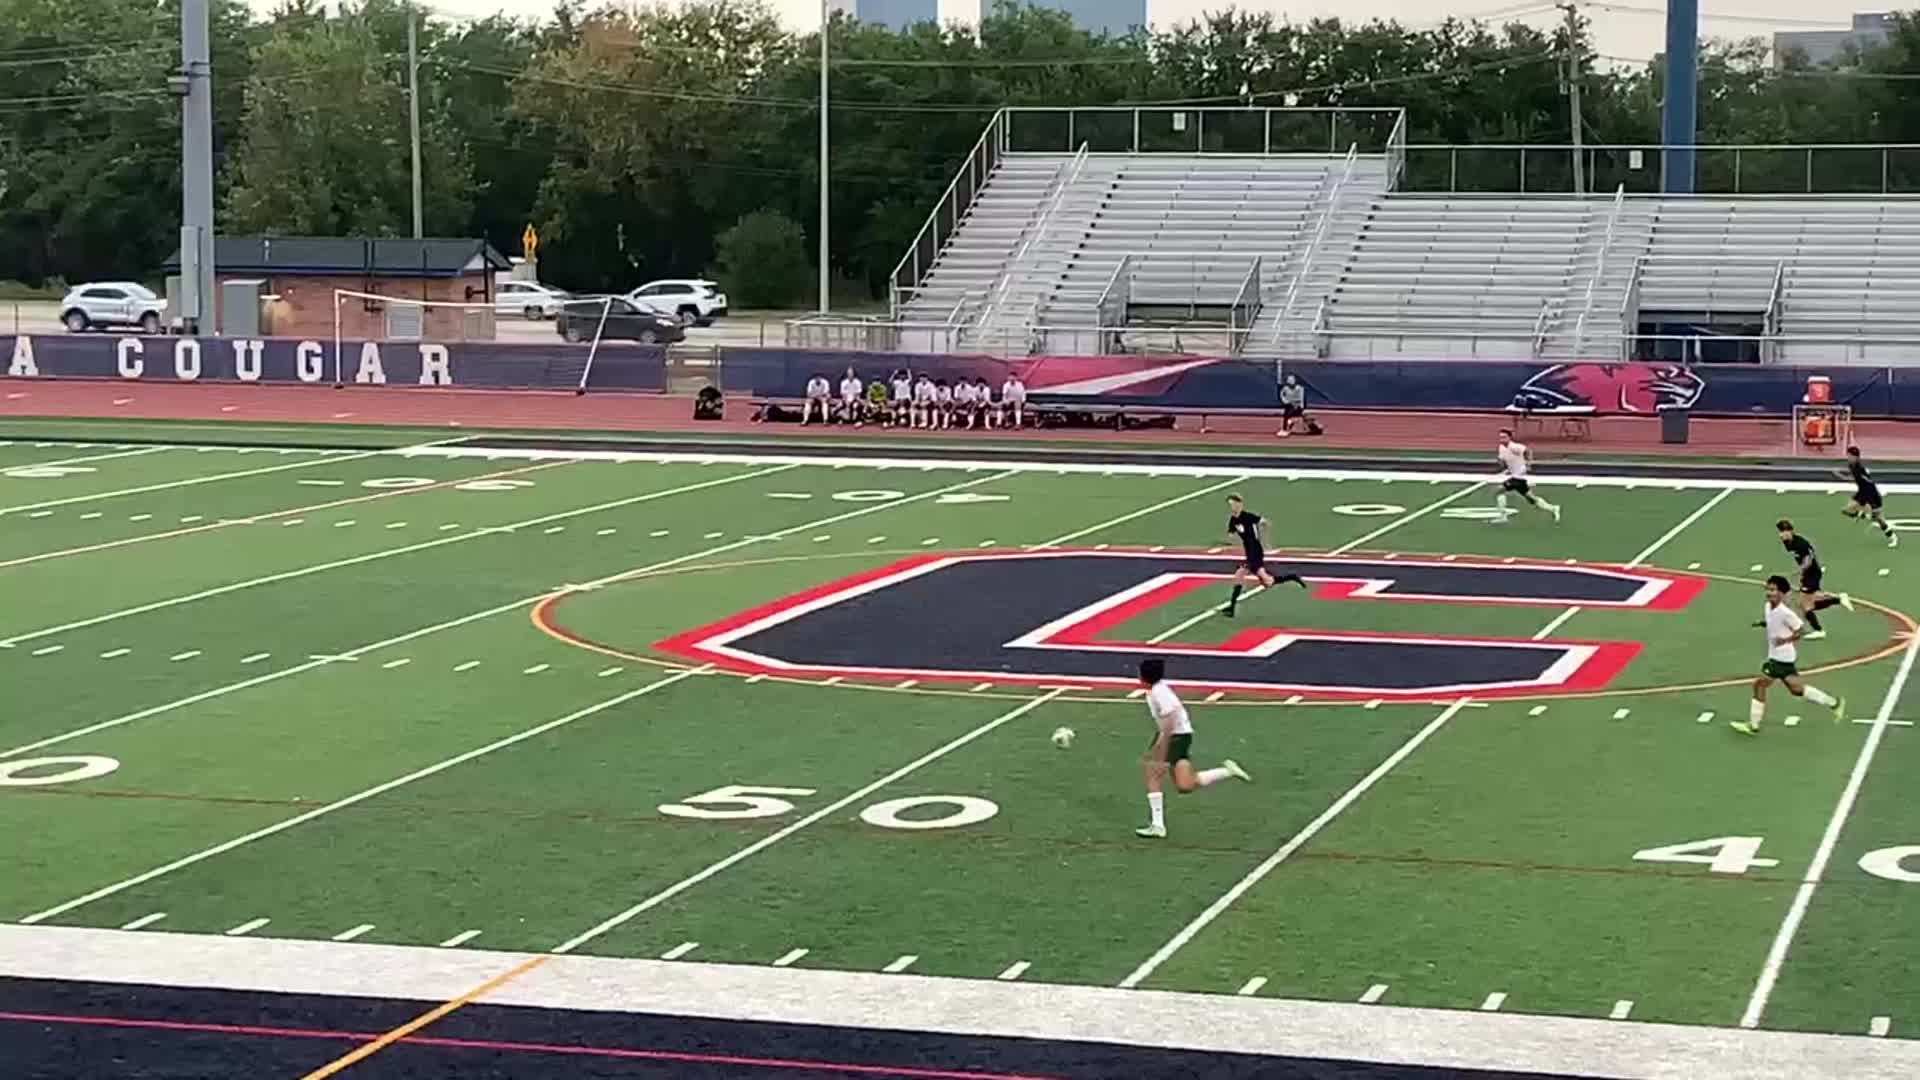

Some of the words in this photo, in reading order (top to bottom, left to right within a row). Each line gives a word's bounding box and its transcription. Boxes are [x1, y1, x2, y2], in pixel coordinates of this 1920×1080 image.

[8, 336, 40, 377] A
[117, 336, 452, 385] COUGAR
[658, 785, 999, 830] 50
